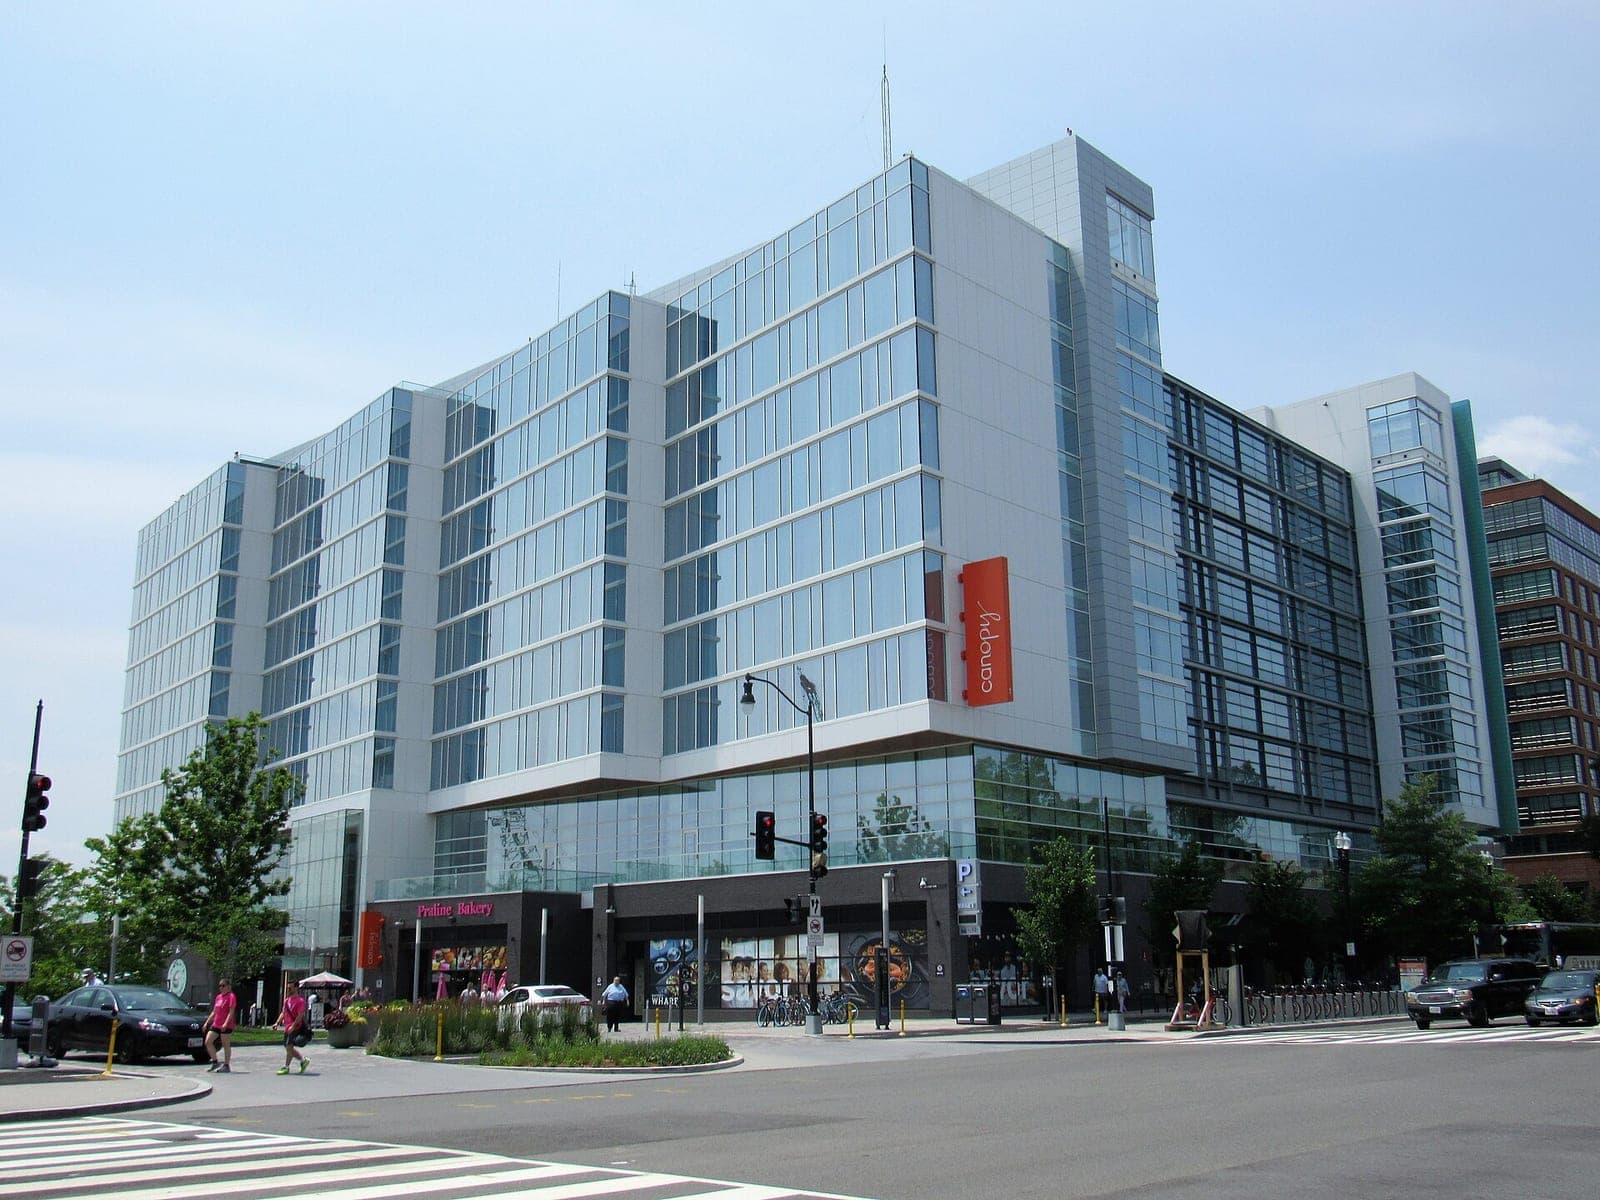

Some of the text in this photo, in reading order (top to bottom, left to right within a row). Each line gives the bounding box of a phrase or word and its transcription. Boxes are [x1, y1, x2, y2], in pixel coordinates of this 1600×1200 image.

[977, 601, 1000, 693] canopy
[958, 863, 972, 882] P
[418, 902, 493, 917] Praline Bakery
